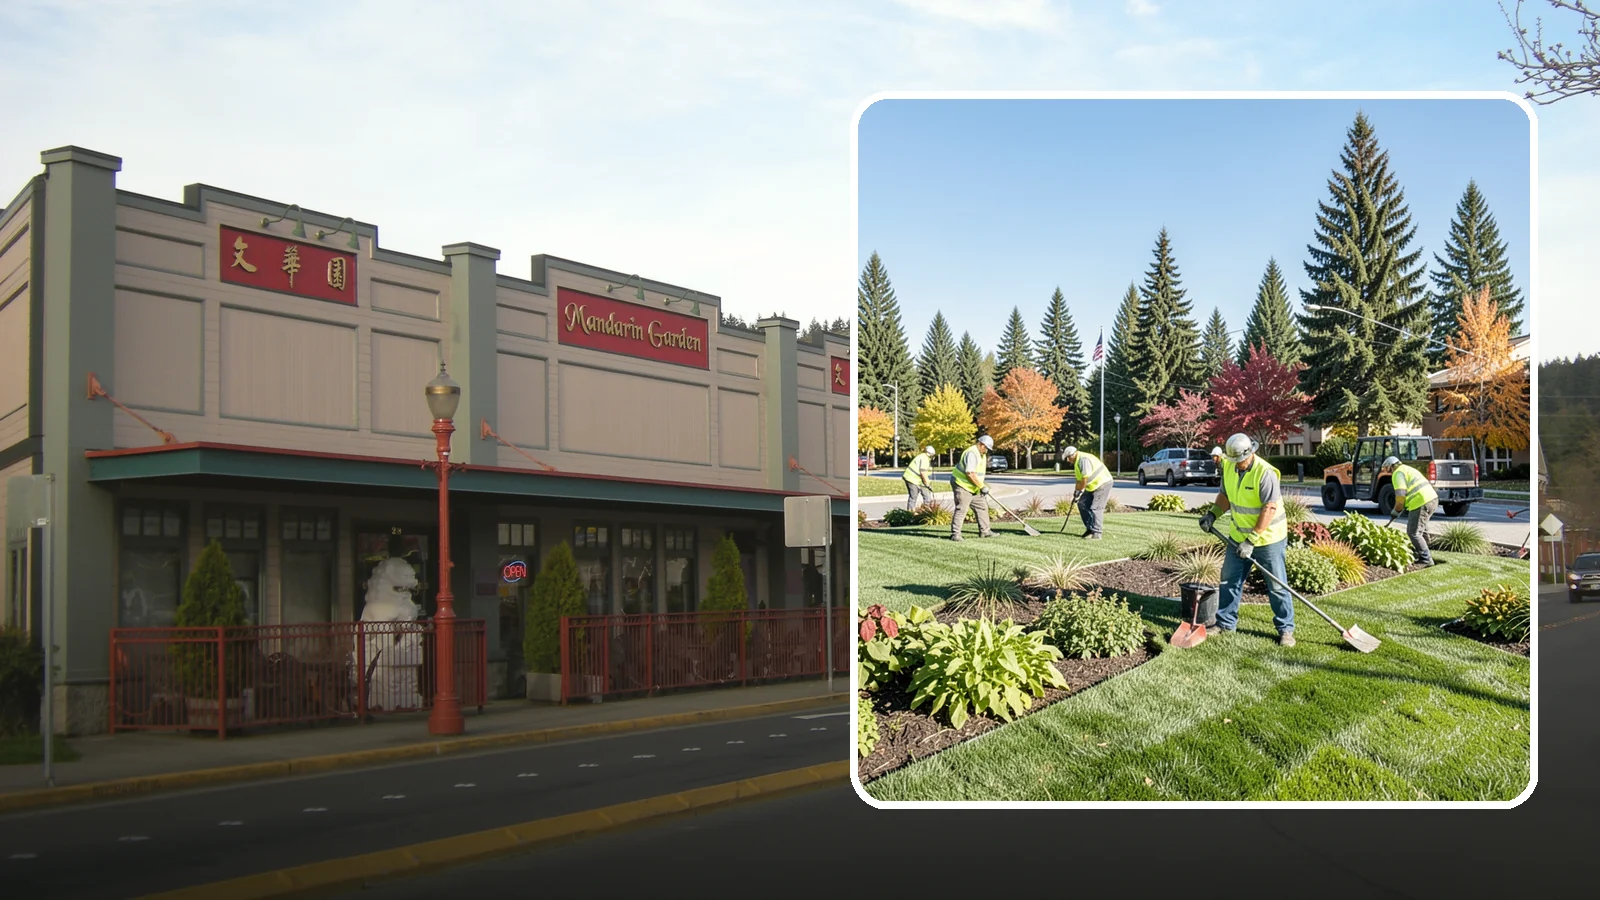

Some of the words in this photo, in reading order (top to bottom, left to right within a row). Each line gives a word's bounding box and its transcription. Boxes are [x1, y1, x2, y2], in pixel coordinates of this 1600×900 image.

[231, 235, 346, 291] 文華園
[564, 302, 644, 341] Mandarin
[648, 320, 701, 352] Garden
[503, 565, 527, 578] OPEN
